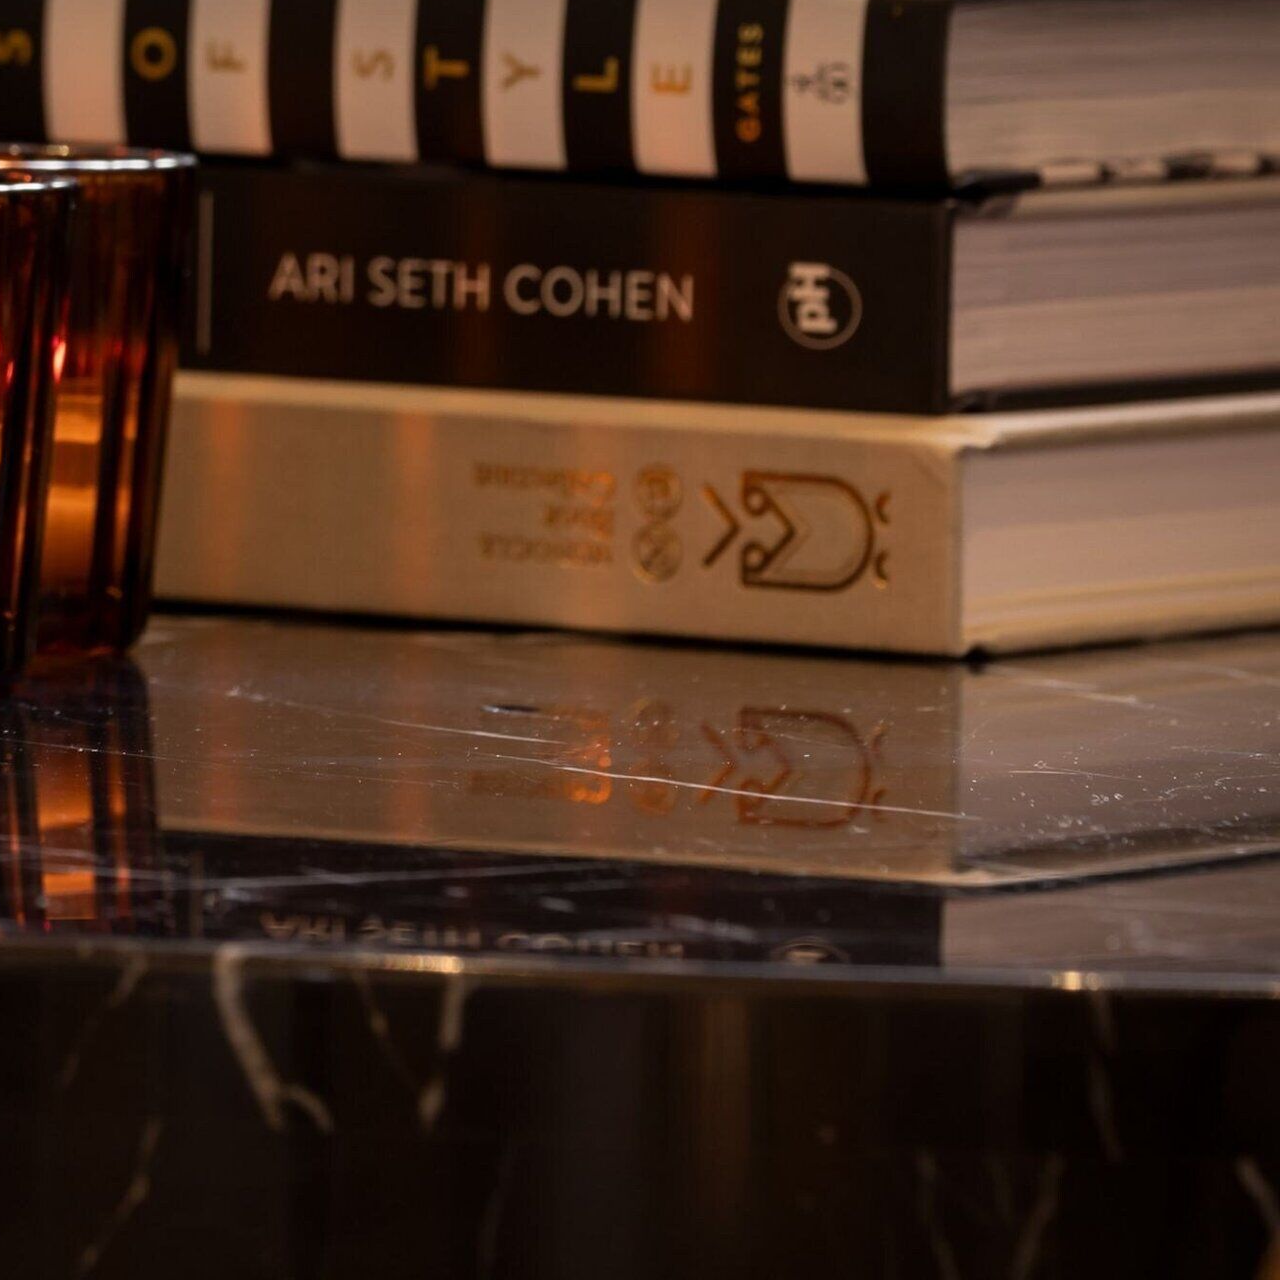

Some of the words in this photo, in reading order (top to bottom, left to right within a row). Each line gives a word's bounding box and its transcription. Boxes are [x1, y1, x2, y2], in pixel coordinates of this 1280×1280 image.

[128, 24, 245, 82] OF
[351, 43, 693, 97] STYLE
[735, 22, 763, 143] GATES
[269, 251, 354, 306] ARI
[367, 253, 491, 312] SETH
[503, 263, 694, 323] COHEN
